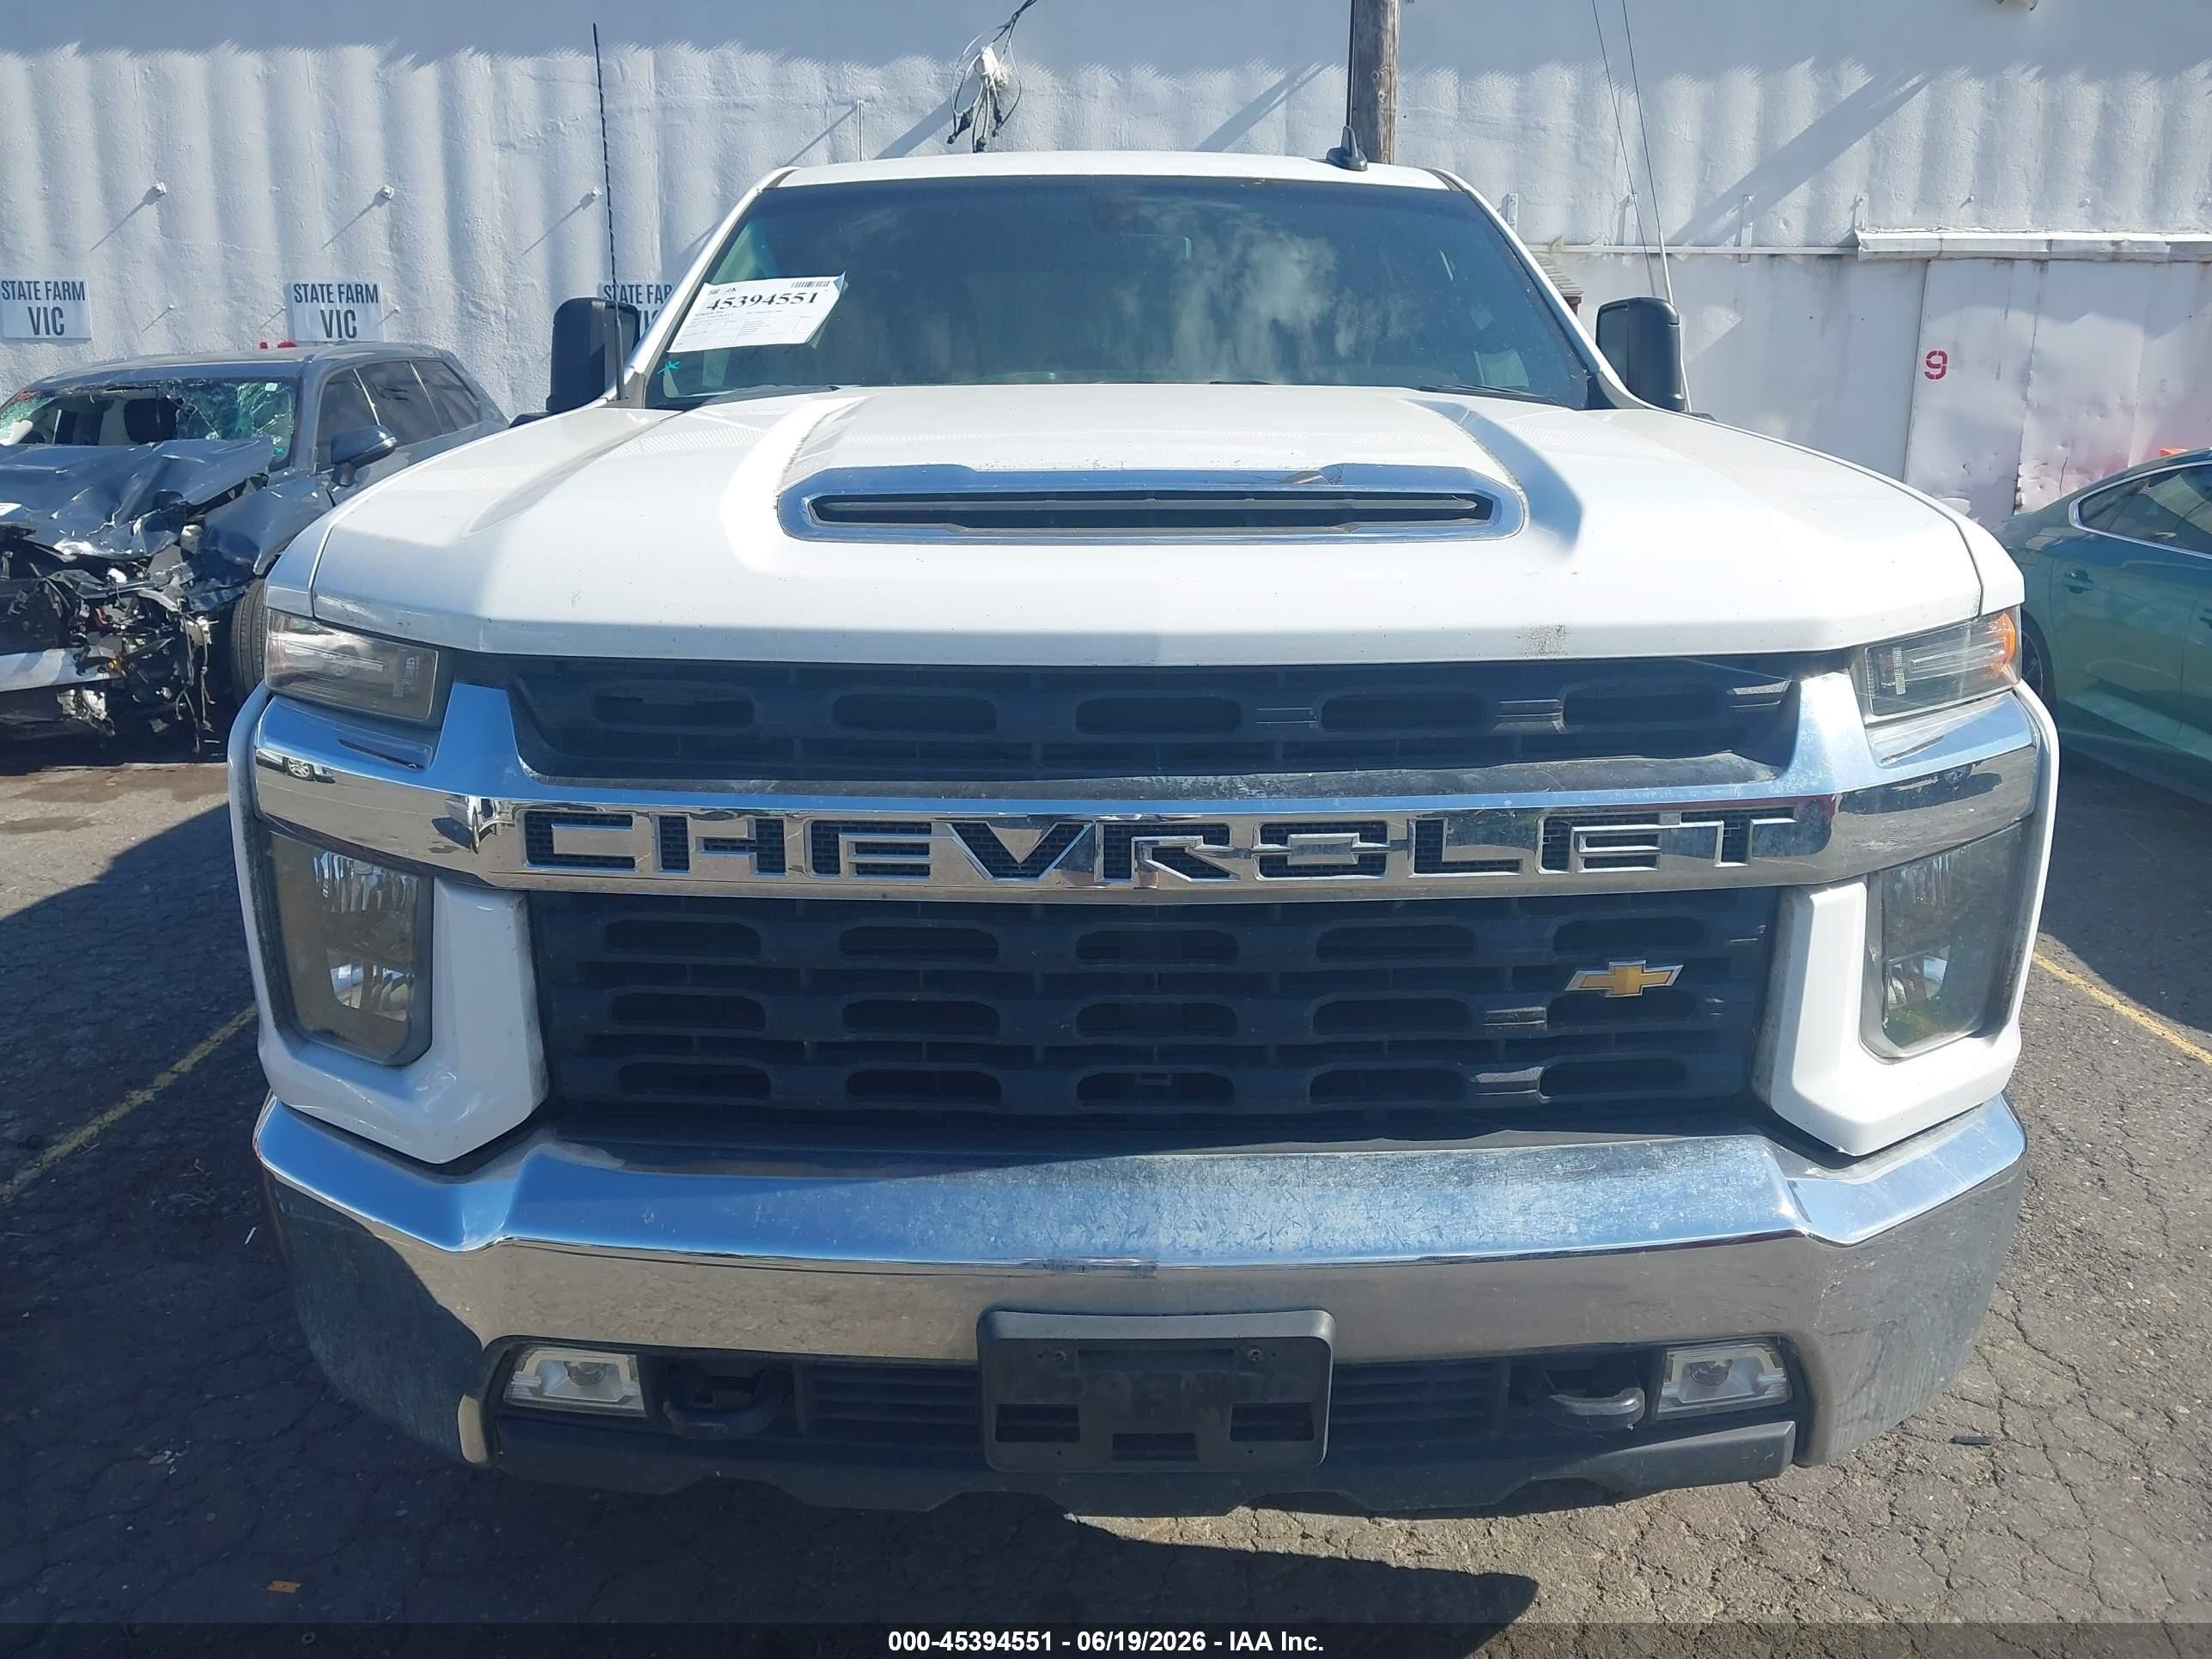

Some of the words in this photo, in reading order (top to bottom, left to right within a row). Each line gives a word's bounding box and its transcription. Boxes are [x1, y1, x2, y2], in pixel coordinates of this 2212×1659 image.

[1, 280, 41, 301] STATE
[45, 281, 86, 301] FARM
[294, 283, 334, 303] STATE
[337, 283, 379, 304] FARM
[706, 292, 819, 311] 45394551
[27, 307, 65, 336] VIC
[319, 309, 357, 338] VIC
[1924, 350, 1948, 380] 9
[522, 805, 1797, 882] CHEVROLET
